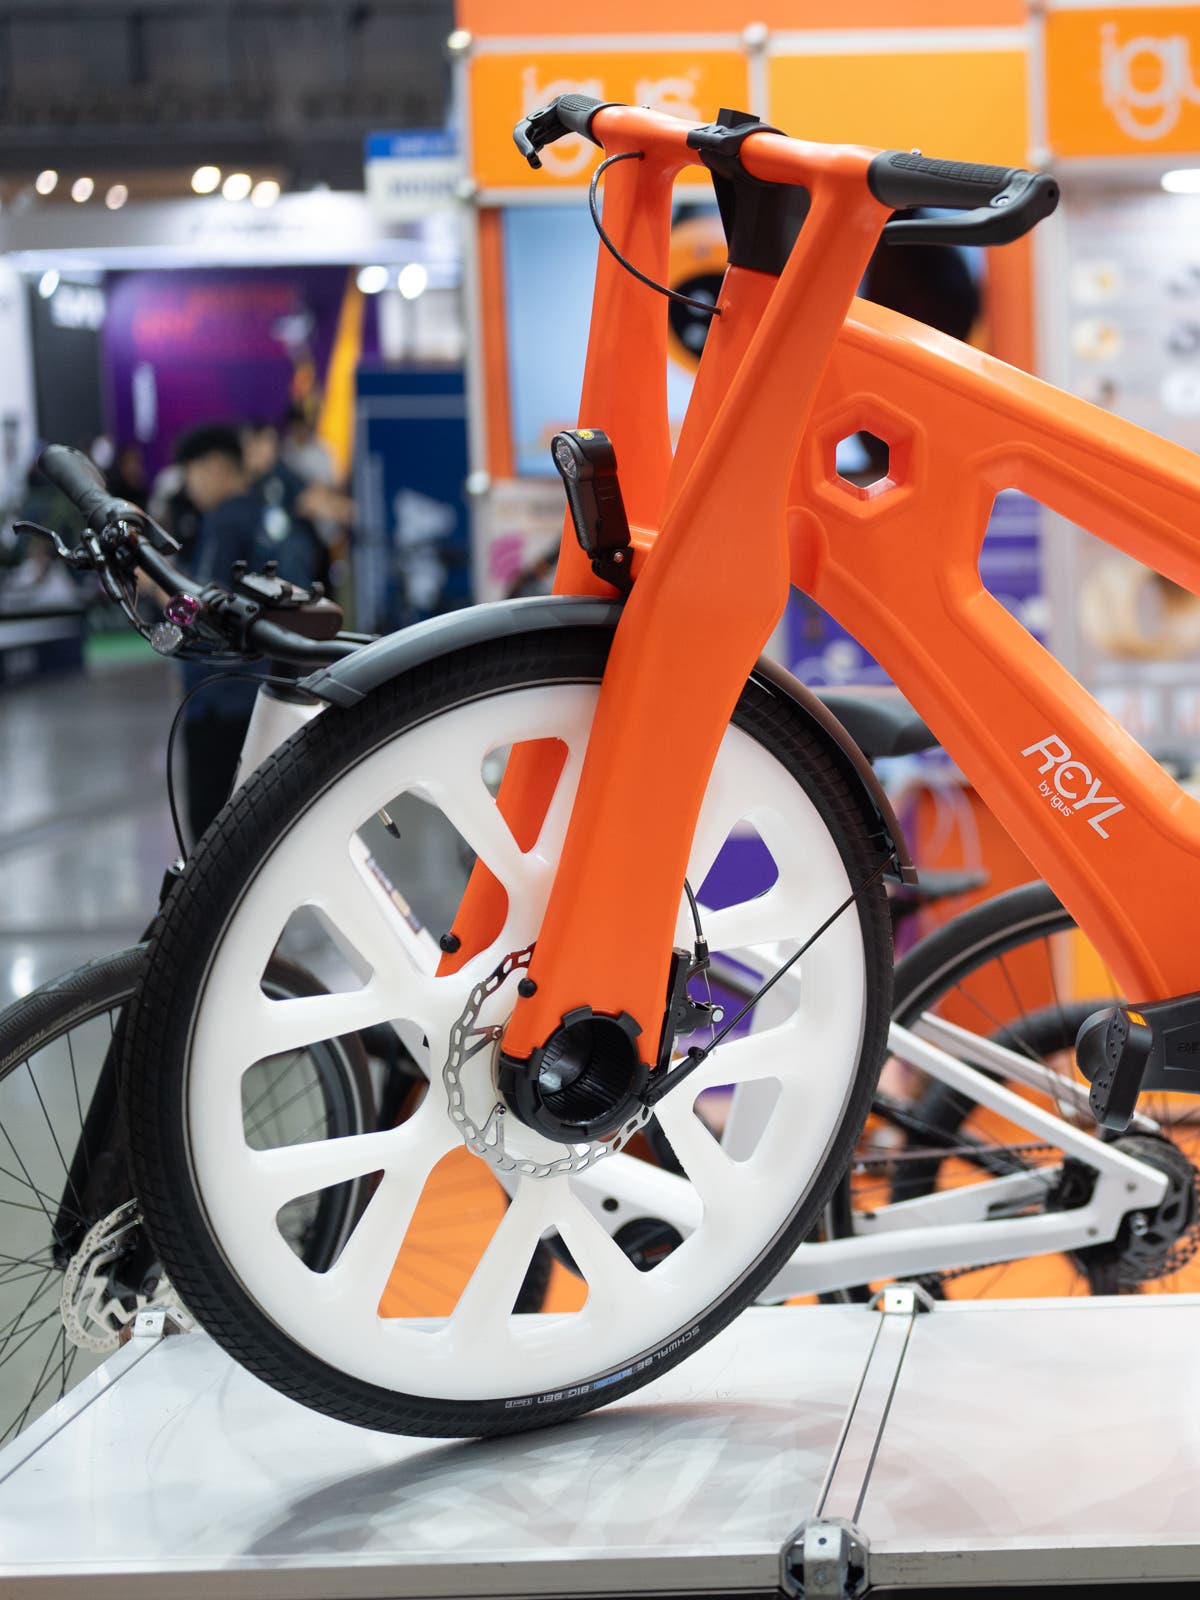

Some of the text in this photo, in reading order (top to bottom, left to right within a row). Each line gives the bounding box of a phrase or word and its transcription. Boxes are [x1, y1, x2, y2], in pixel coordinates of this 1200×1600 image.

[522, 65, 703, 178] igs
[1020, 733, 1127, 840] RCYL
[1038, 780, 1054, 797] by
[635, 1324, 700, 1371] SCHWALBE
[537, 1392, 563, 1404] BEN
[567, 1385, 591, 1399] BIG
